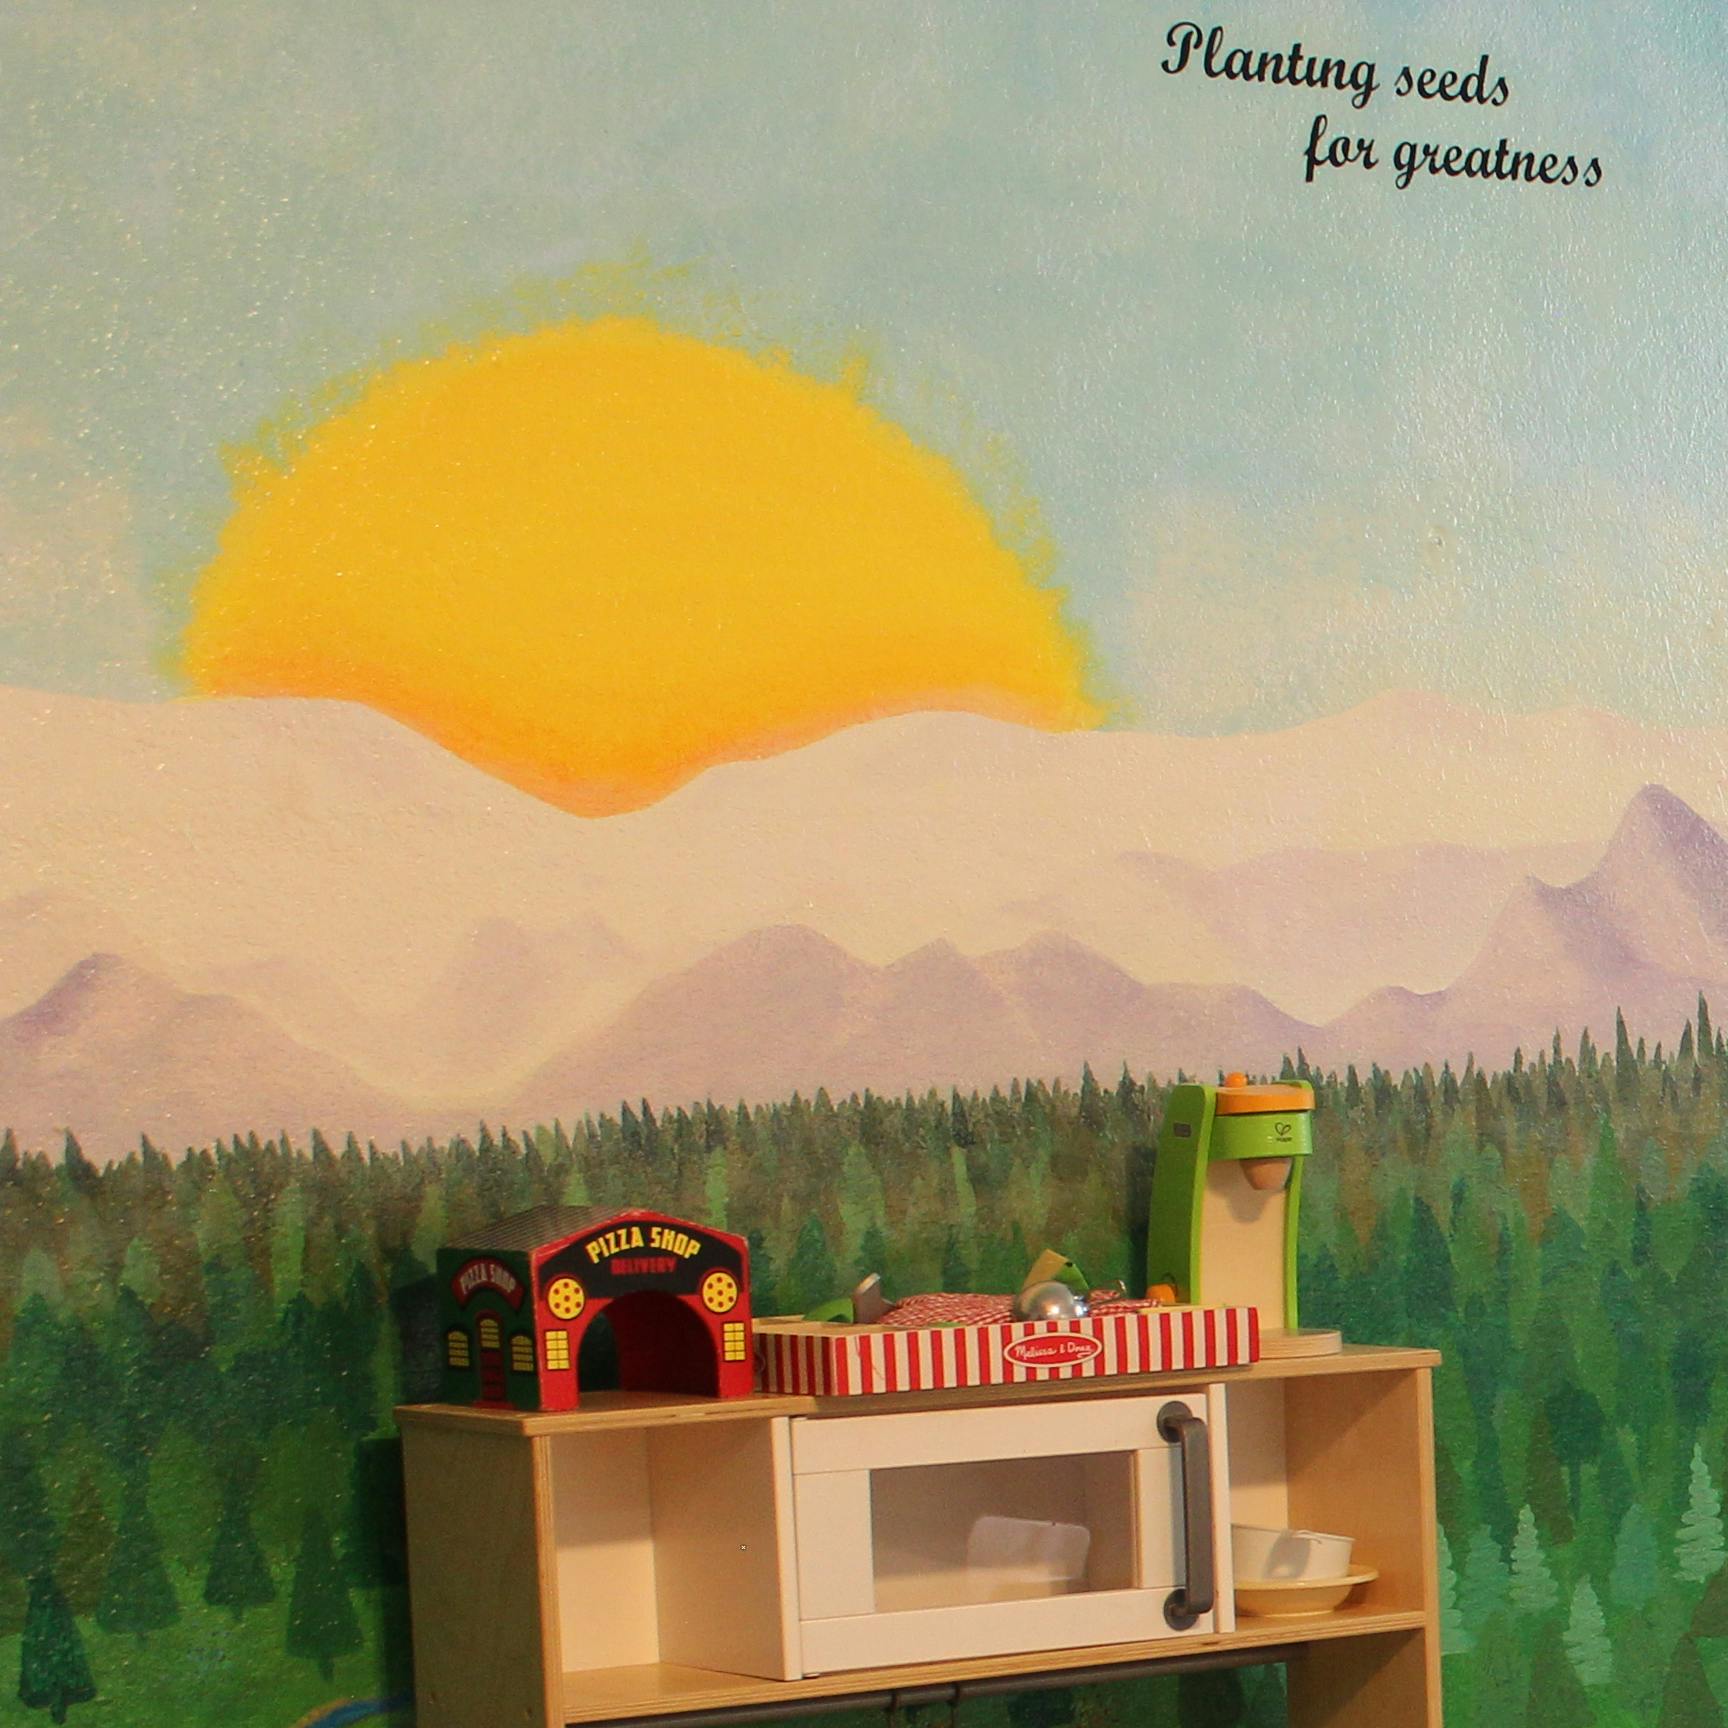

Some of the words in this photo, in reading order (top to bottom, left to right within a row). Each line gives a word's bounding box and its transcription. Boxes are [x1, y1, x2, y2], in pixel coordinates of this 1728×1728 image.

[1161, 21, 1380, 109] Planting
[1394, 54, 1510, 106] seeds
[1304, 114, 1379, 182] for
[1393, 138, 1602, 190] greatness
[585, 1226, 644, 1264] PIZZA
[650, 1226, 701, 1259] SHOP
[458, 1263, 488, 1295] PIZZA
